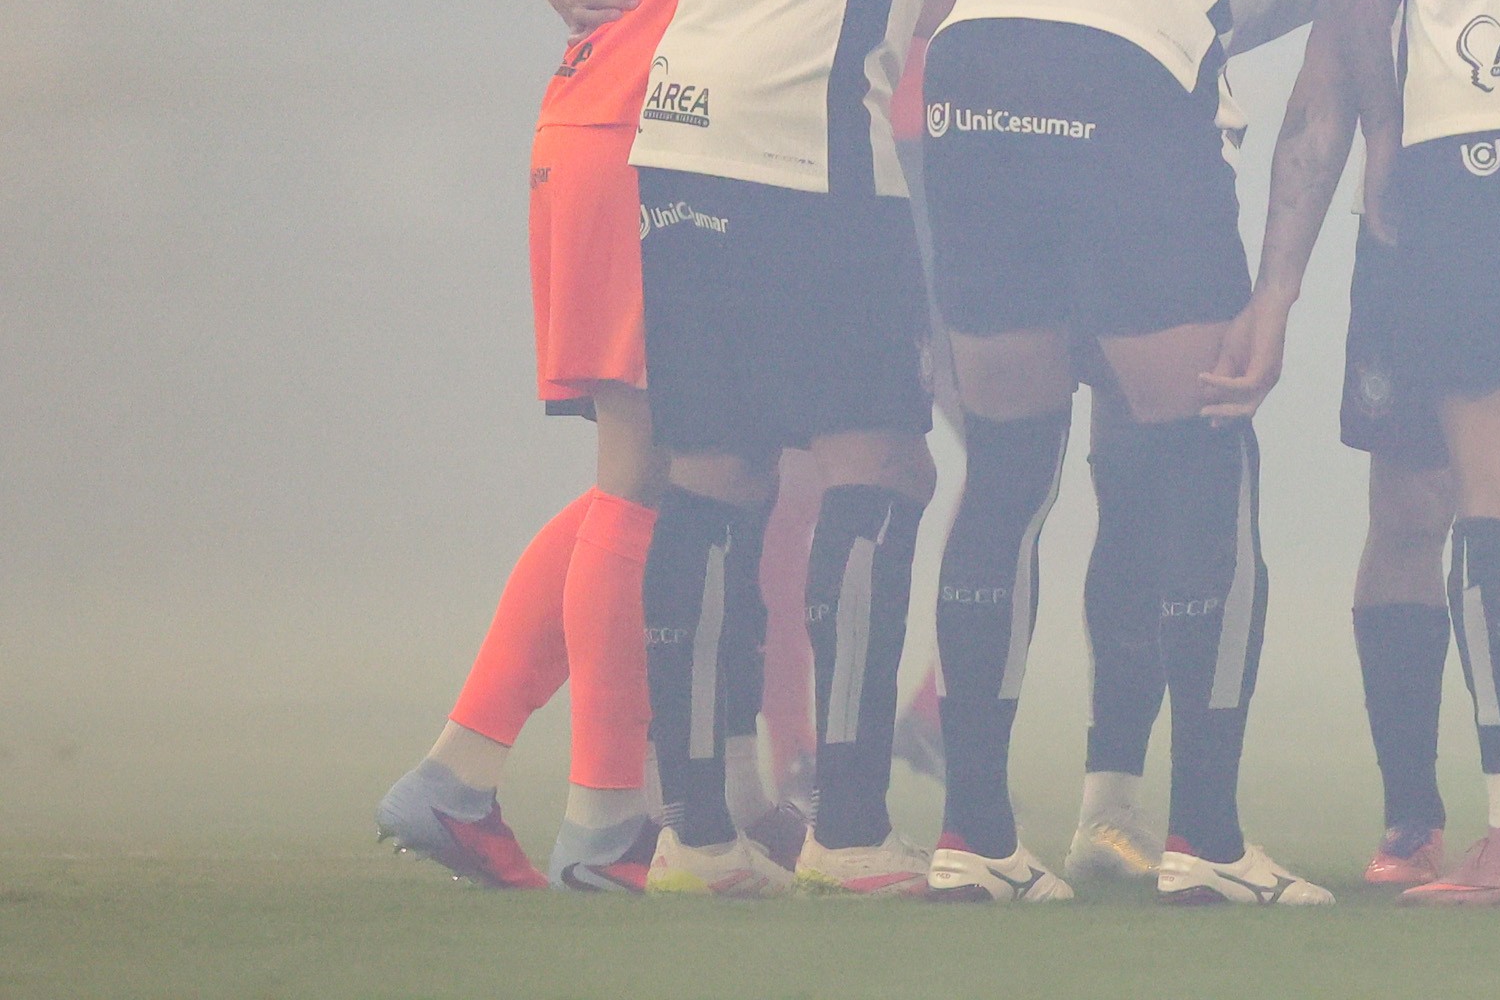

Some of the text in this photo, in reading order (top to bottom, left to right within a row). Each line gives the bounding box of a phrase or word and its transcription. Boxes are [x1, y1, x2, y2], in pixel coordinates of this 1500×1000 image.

[646, 81, 709, 116] AREA
[956, 108, 1096, 139] UniCesumar
[651, 201, 729, 233] UniCumar
